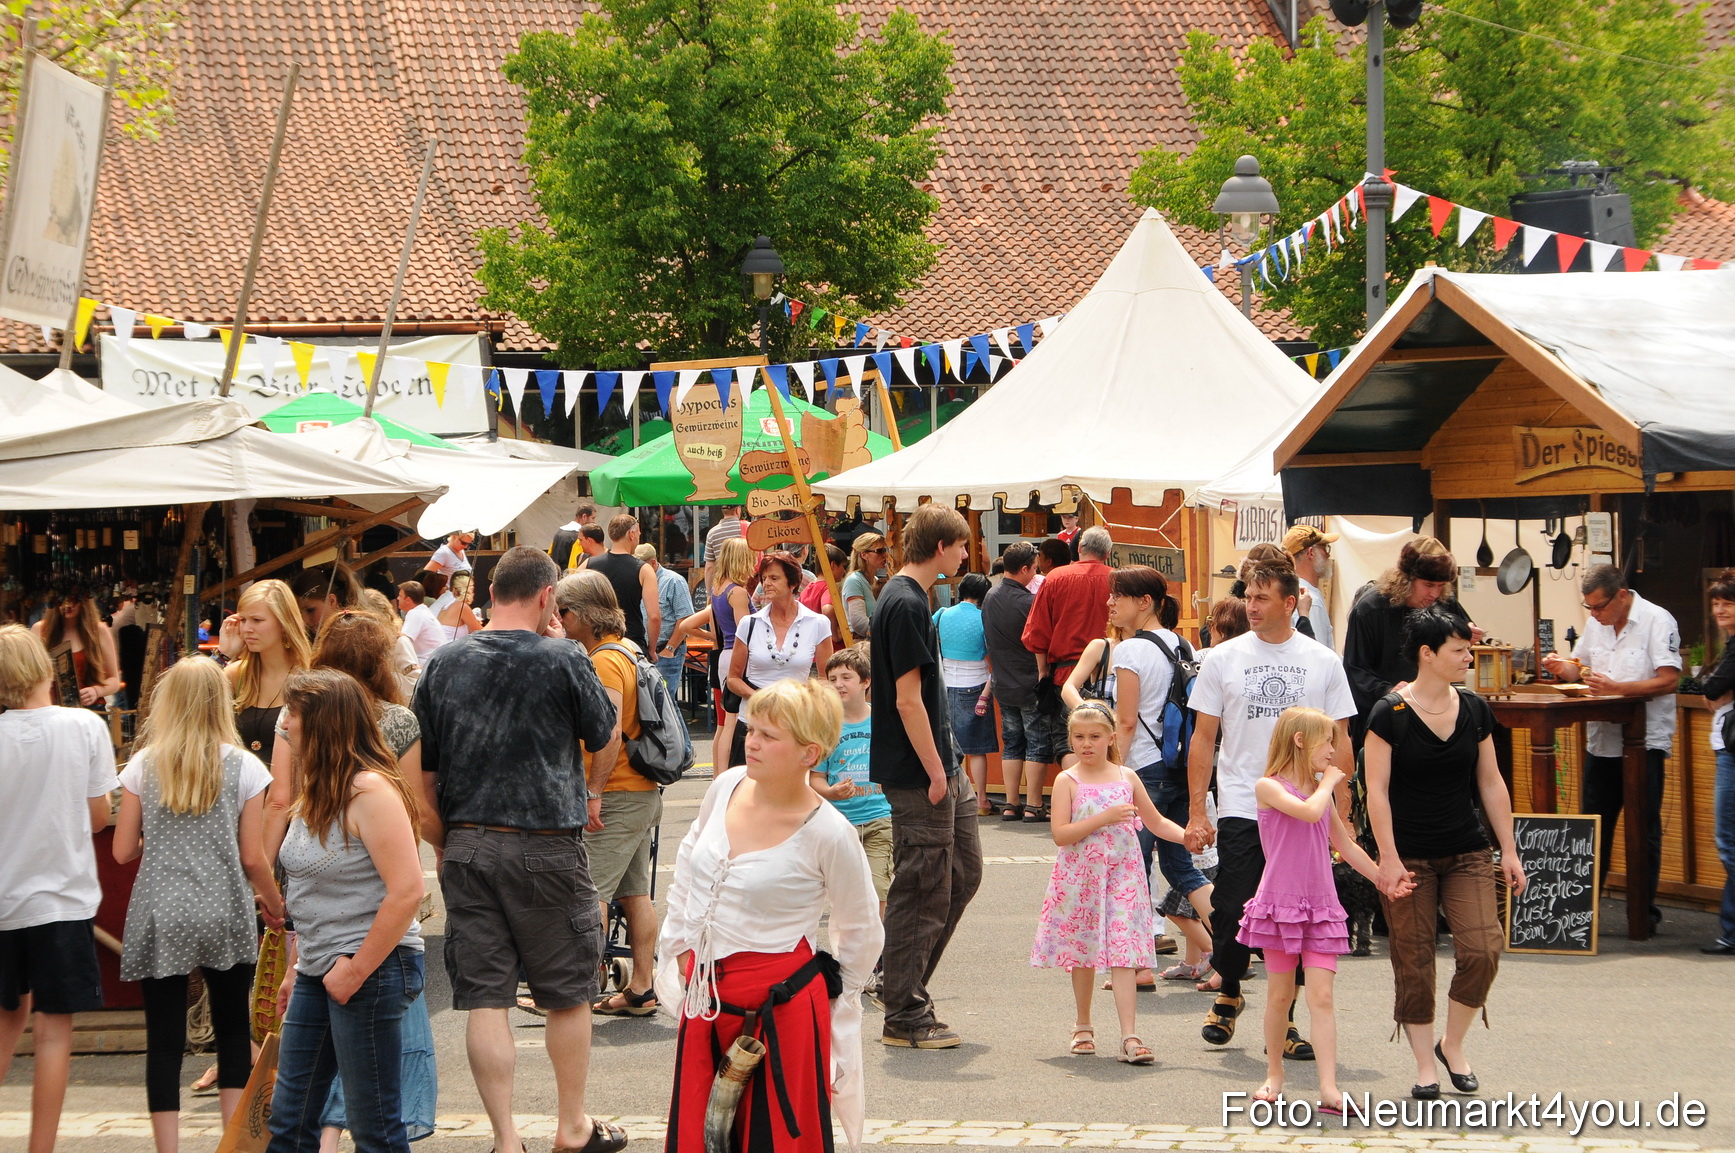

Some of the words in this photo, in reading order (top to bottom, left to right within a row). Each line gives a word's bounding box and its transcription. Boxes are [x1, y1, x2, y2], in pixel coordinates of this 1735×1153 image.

[132, 368, 198, 398] Met
[676, 420, 739, 433] Gewürzweine
[687, 446, 705, 456] auch
[707, 446, 723, 459] heiß
[1520, 431, 1566, 470] Der
[740, 457, 810, 475] Gewürzwne
[767, 525, 801, 539] Liköre
[1239, 504, 1279, 543] LIBRIS
[1244, 665, 1270, 676] WEST
[1277, 665, 1308, 676] COAST
[1250, 694, 1298, 705] UNIVERSITY
[1247, 704, 1298, 720] SPOR
[1515, 820, 1572, 854] Kommt
[1572, 826, 1595, 857] und
[1574, 858, 1594, 878] der
[1511, 924, 1548, 945] Beim
[1546, 908, 1594, 944] Spiesser
